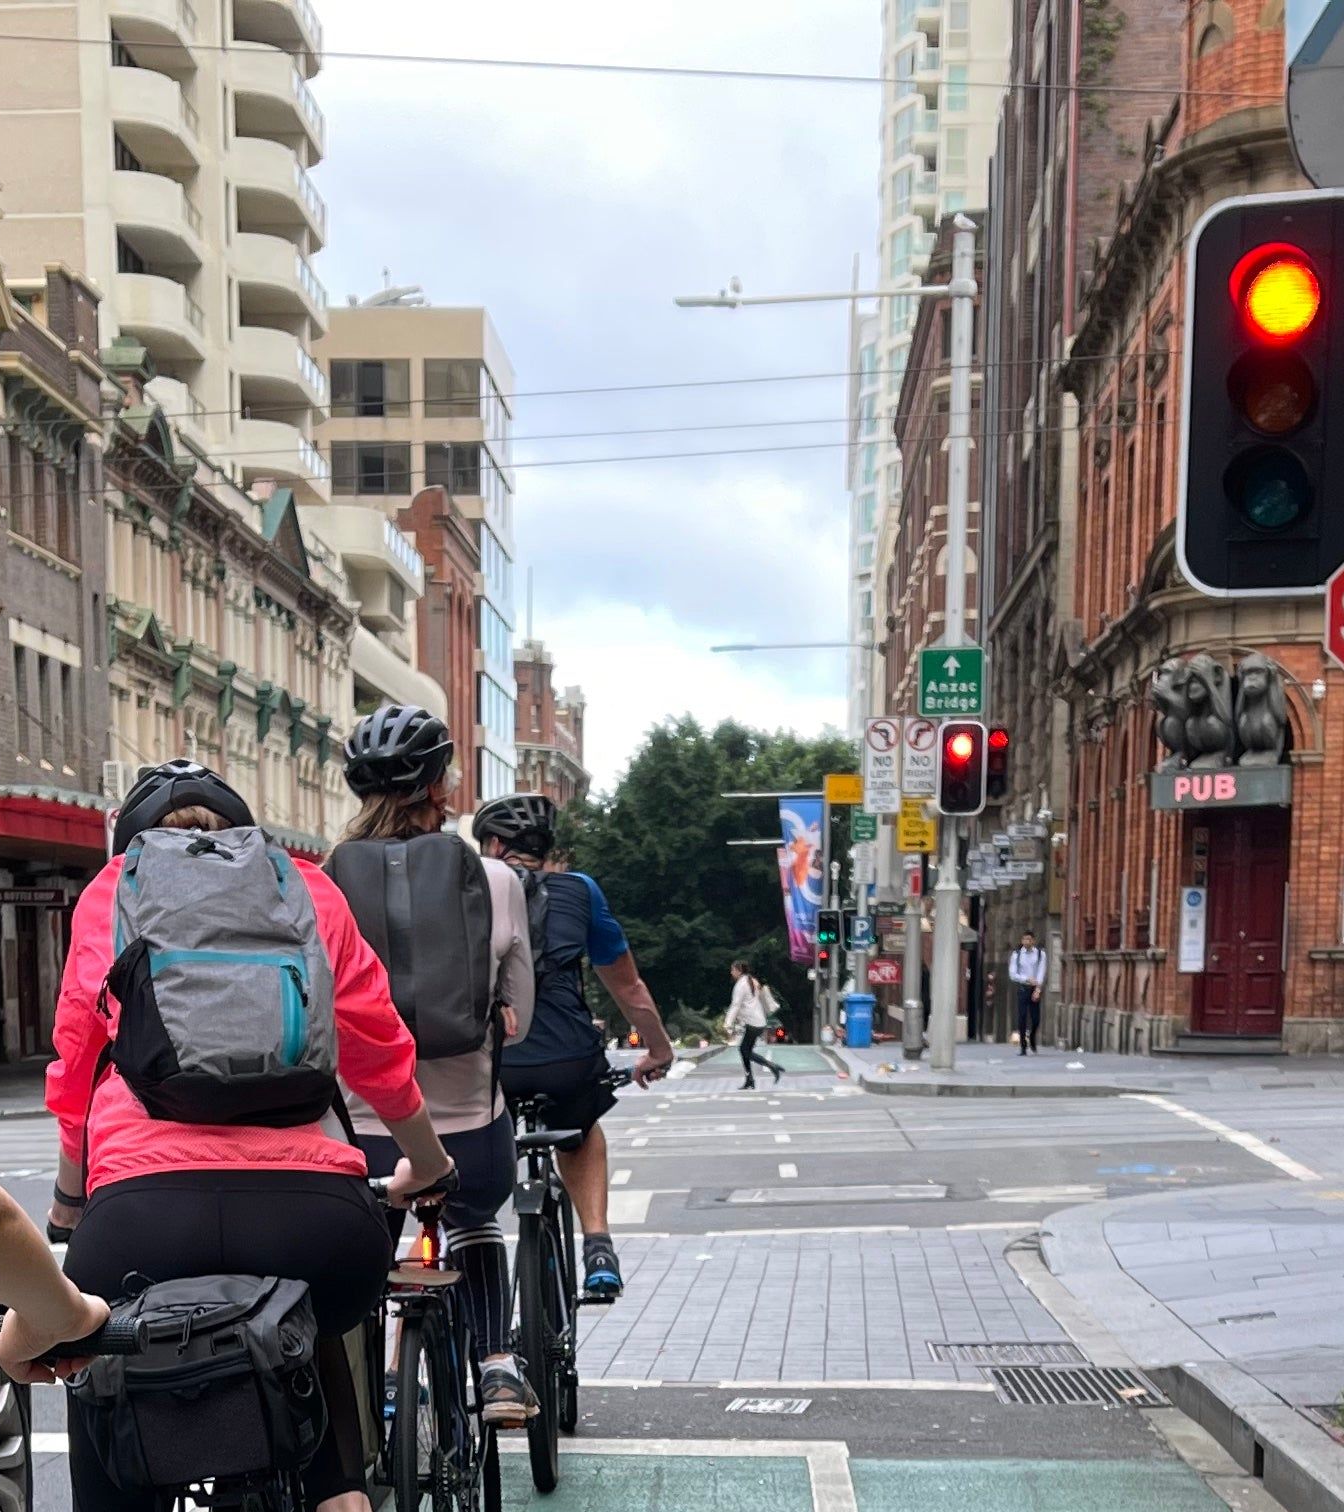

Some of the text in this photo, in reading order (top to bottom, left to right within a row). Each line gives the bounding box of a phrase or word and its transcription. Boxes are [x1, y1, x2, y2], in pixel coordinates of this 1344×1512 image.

[925, 680, 977, 694] Anzac
[924, 696, 978, 712] Bridge
[872, 755, 893, 768] NO
[910, 755, 932, 768] NO
[1174, 774, 1237, 801] PUB
